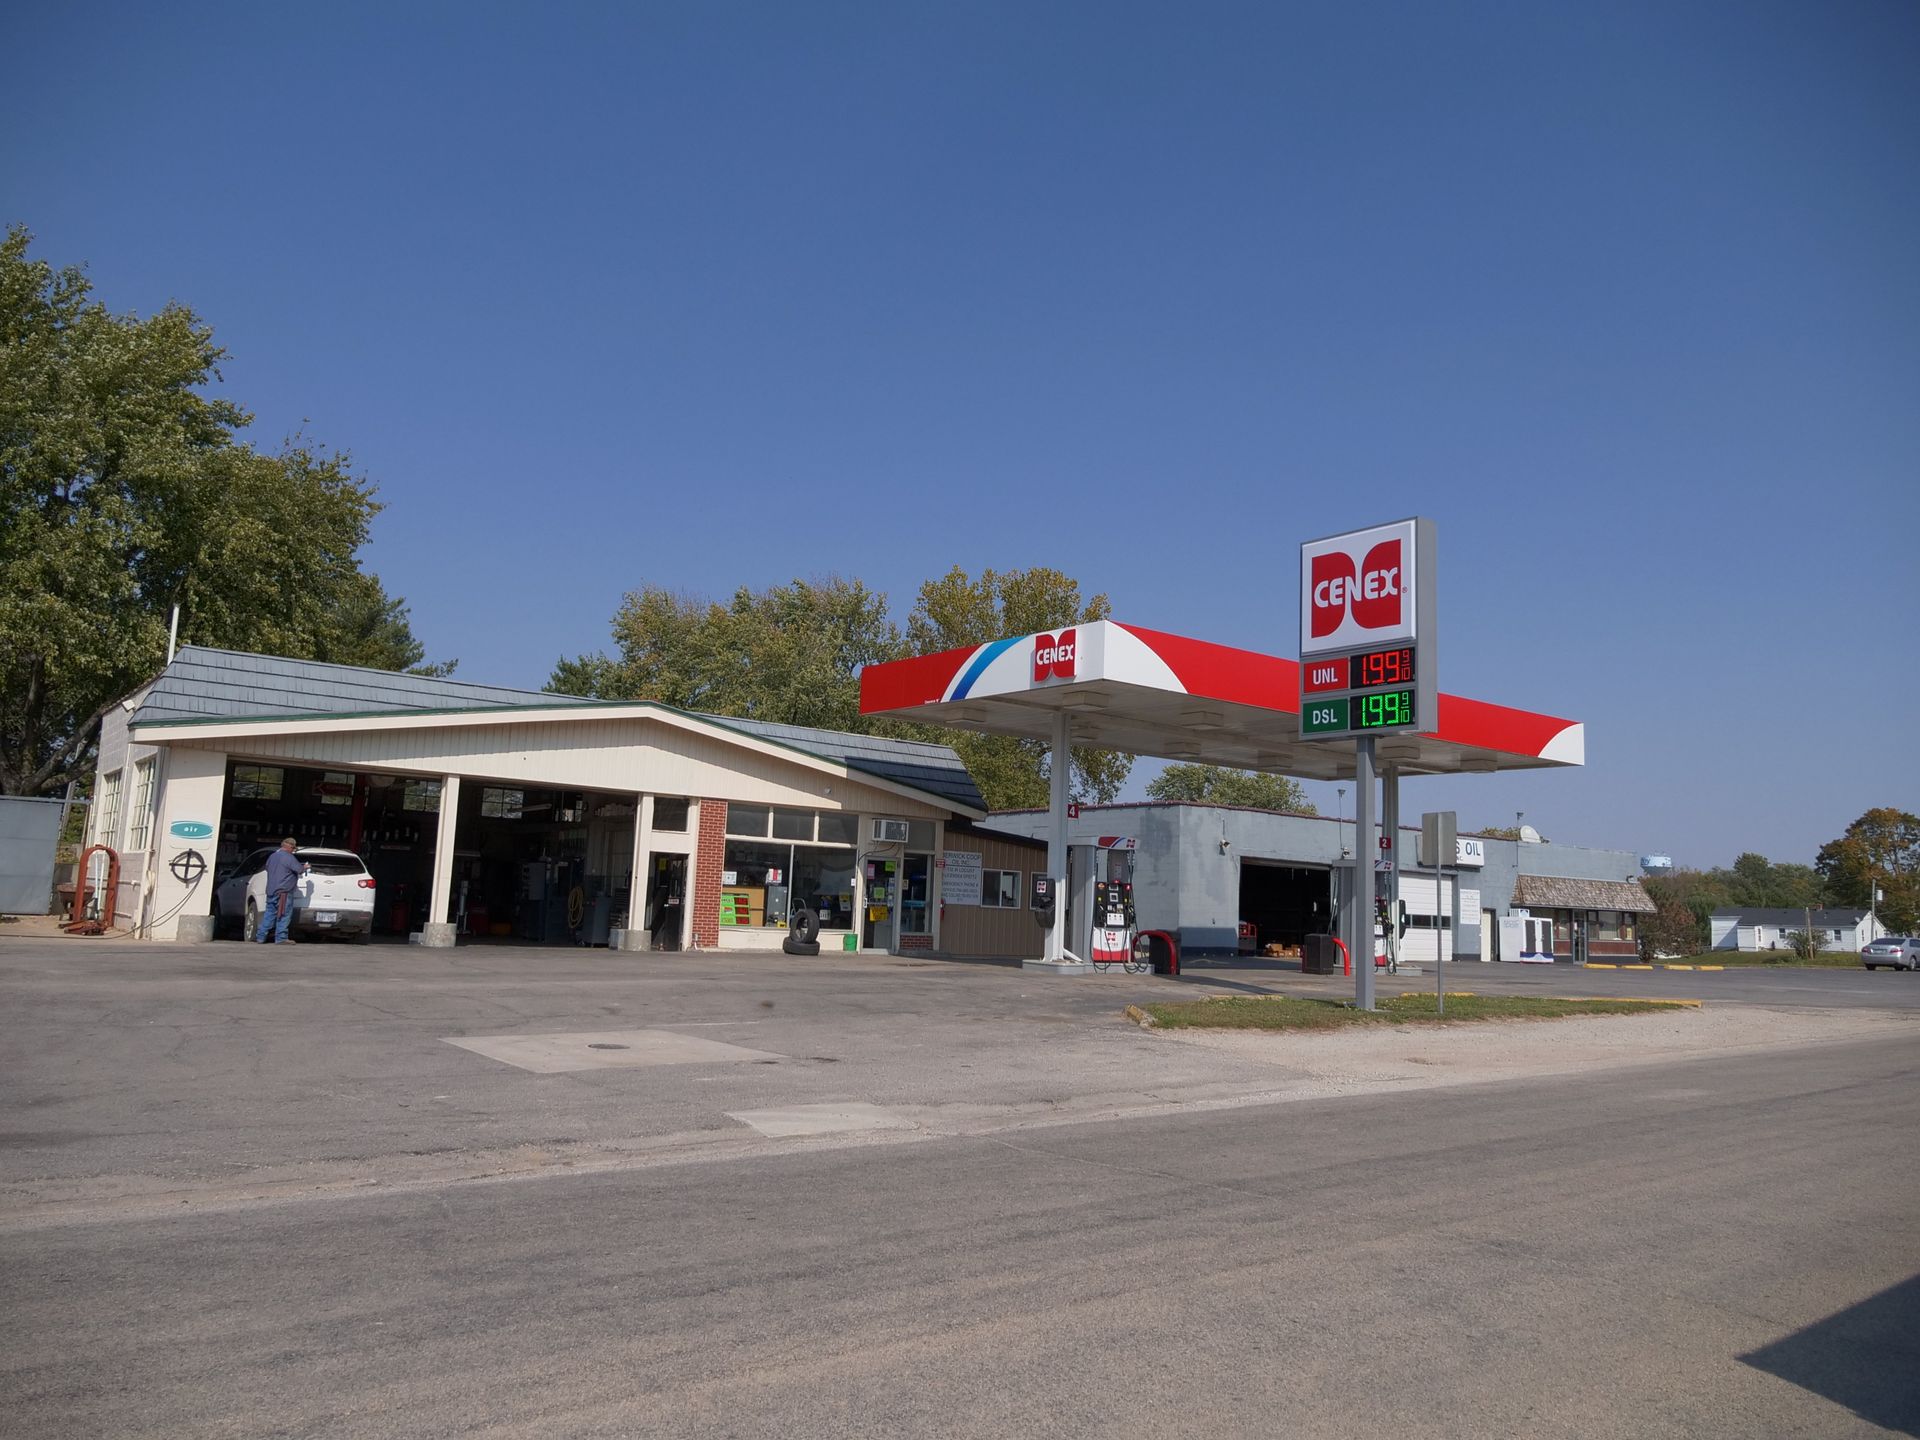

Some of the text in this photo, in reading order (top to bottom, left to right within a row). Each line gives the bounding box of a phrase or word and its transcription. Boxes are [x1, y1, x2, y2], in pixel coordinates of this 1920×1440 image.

[1314, 567, 1398, 608] CENEX
[1037, 644, 1074, 665] CENEX
[1313, 651, 1400, 686] UNL 1.99
[1313, 693, 1399, 727] DSL 1.99
[1069, 805, 1076, 818] 4
[1382, 838, 1387, 848] 2
[1465, 841, 1481, 856] OIL
